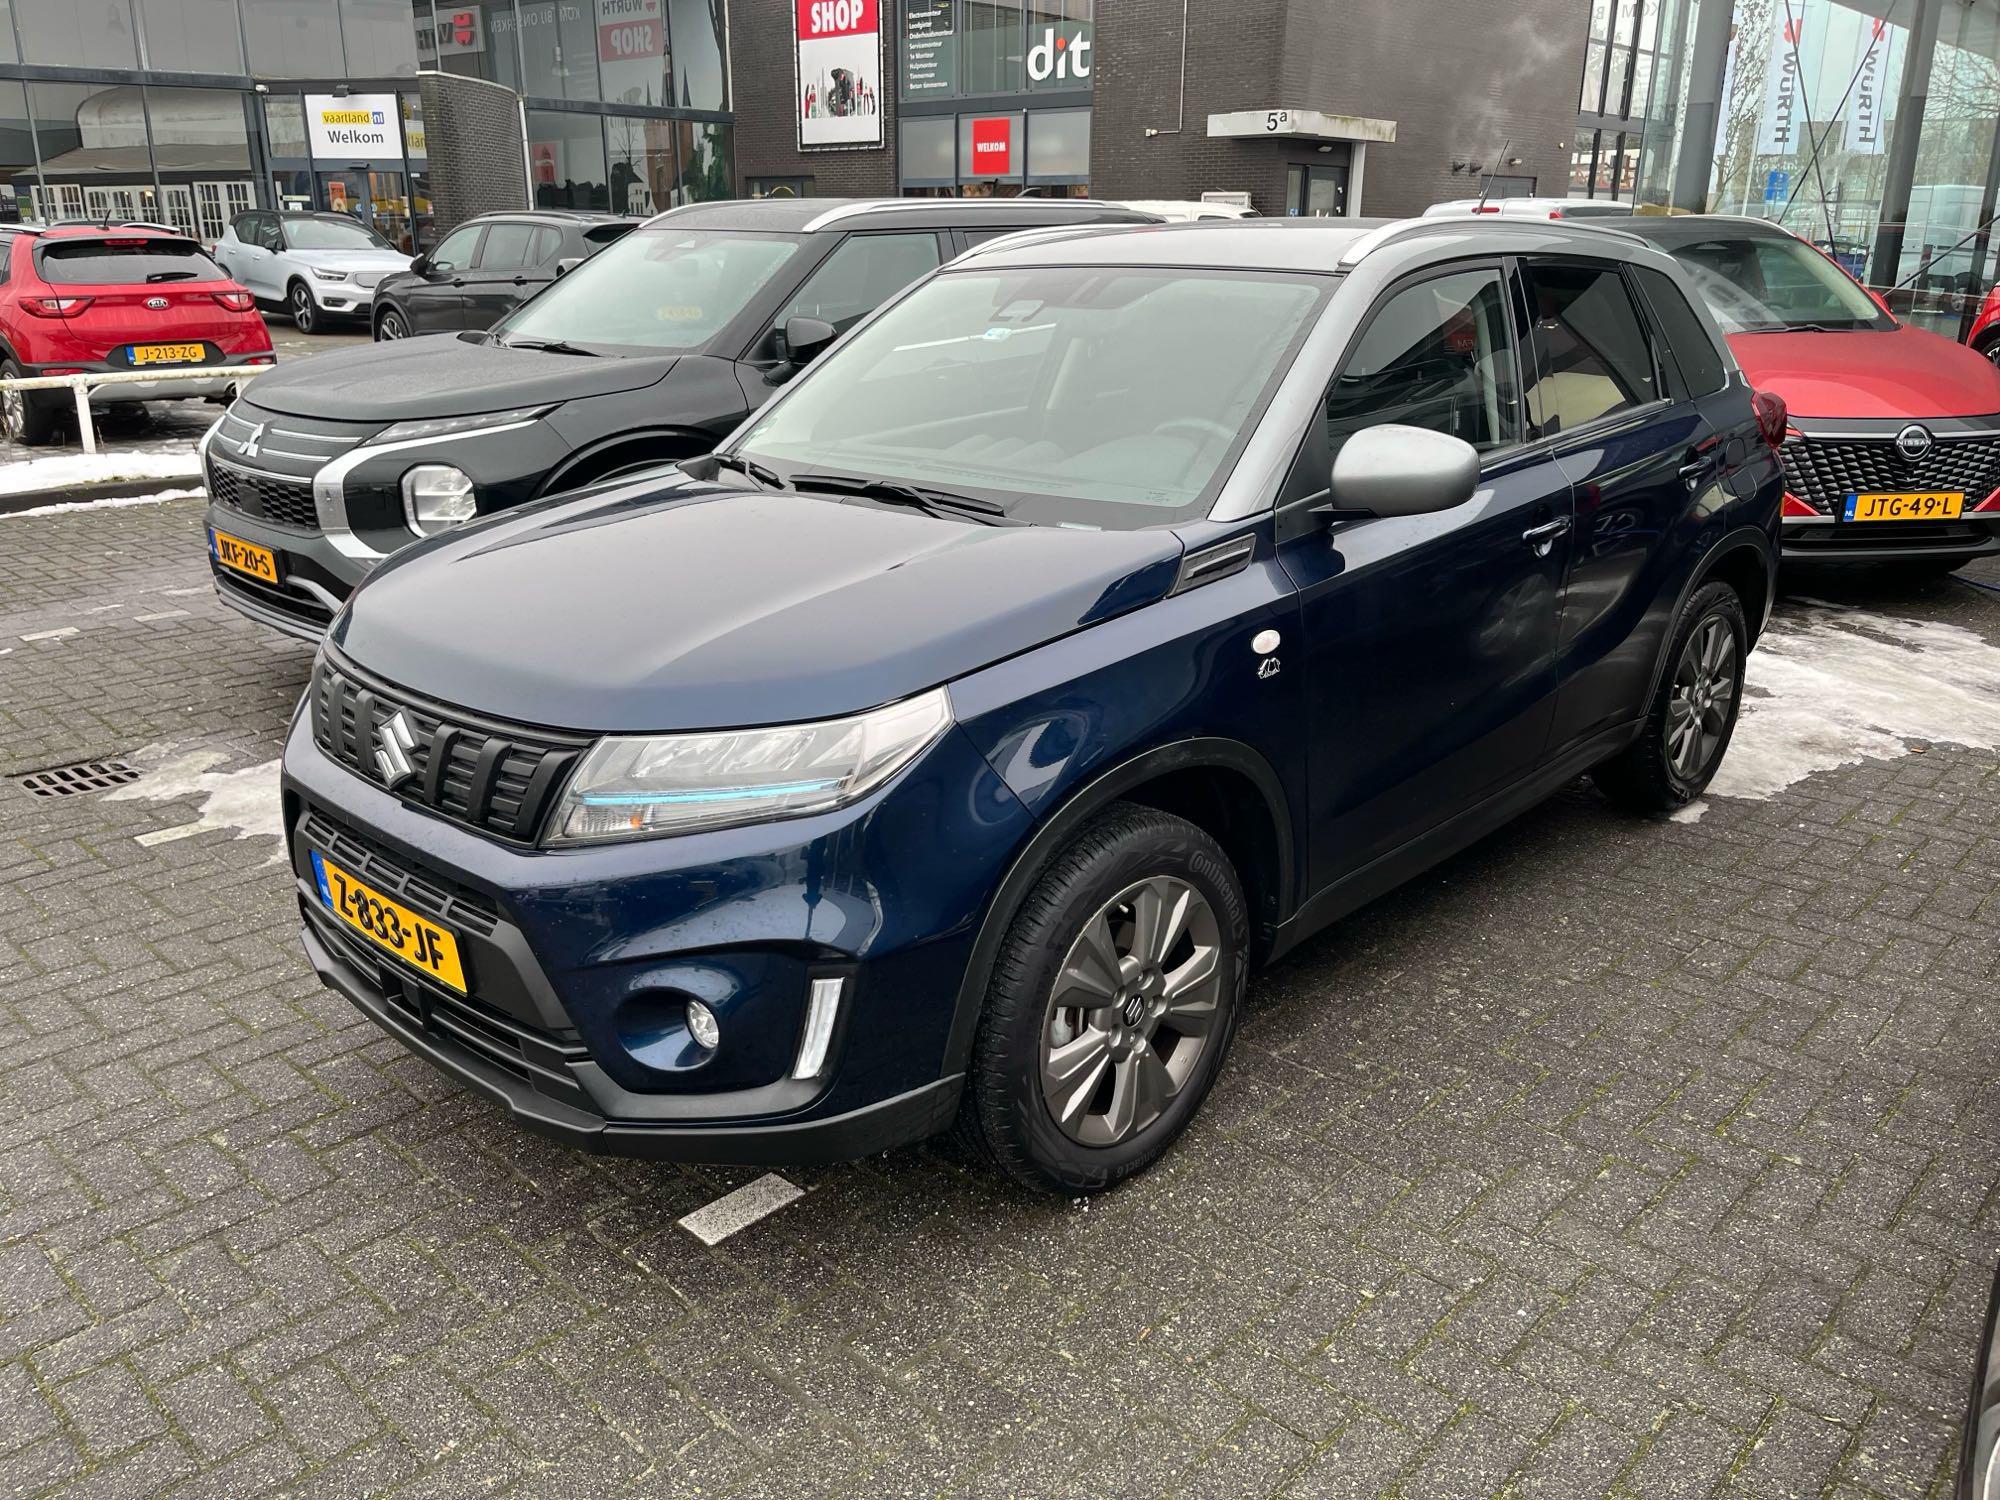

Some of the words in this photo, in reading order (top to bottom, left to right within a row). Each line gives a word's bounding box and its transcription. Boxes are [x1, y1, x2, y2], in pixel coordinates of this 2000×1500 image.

[811, 0, 863, 34] SHOP
[1027, 29, 1091, 81] dit
[328, 130, 384, 144] Welkom
[976, 141, 1006, 153] WELKOM
[143, 346, 197, 360] J-213-ZG
[1864, 497, 1952, 516] JTG-49-L
[220, 539, 271, 576] JKF-20-S
[1189, 850, 1244, 926] Continental
[334, 873, 444, 970] Z-833-JF
